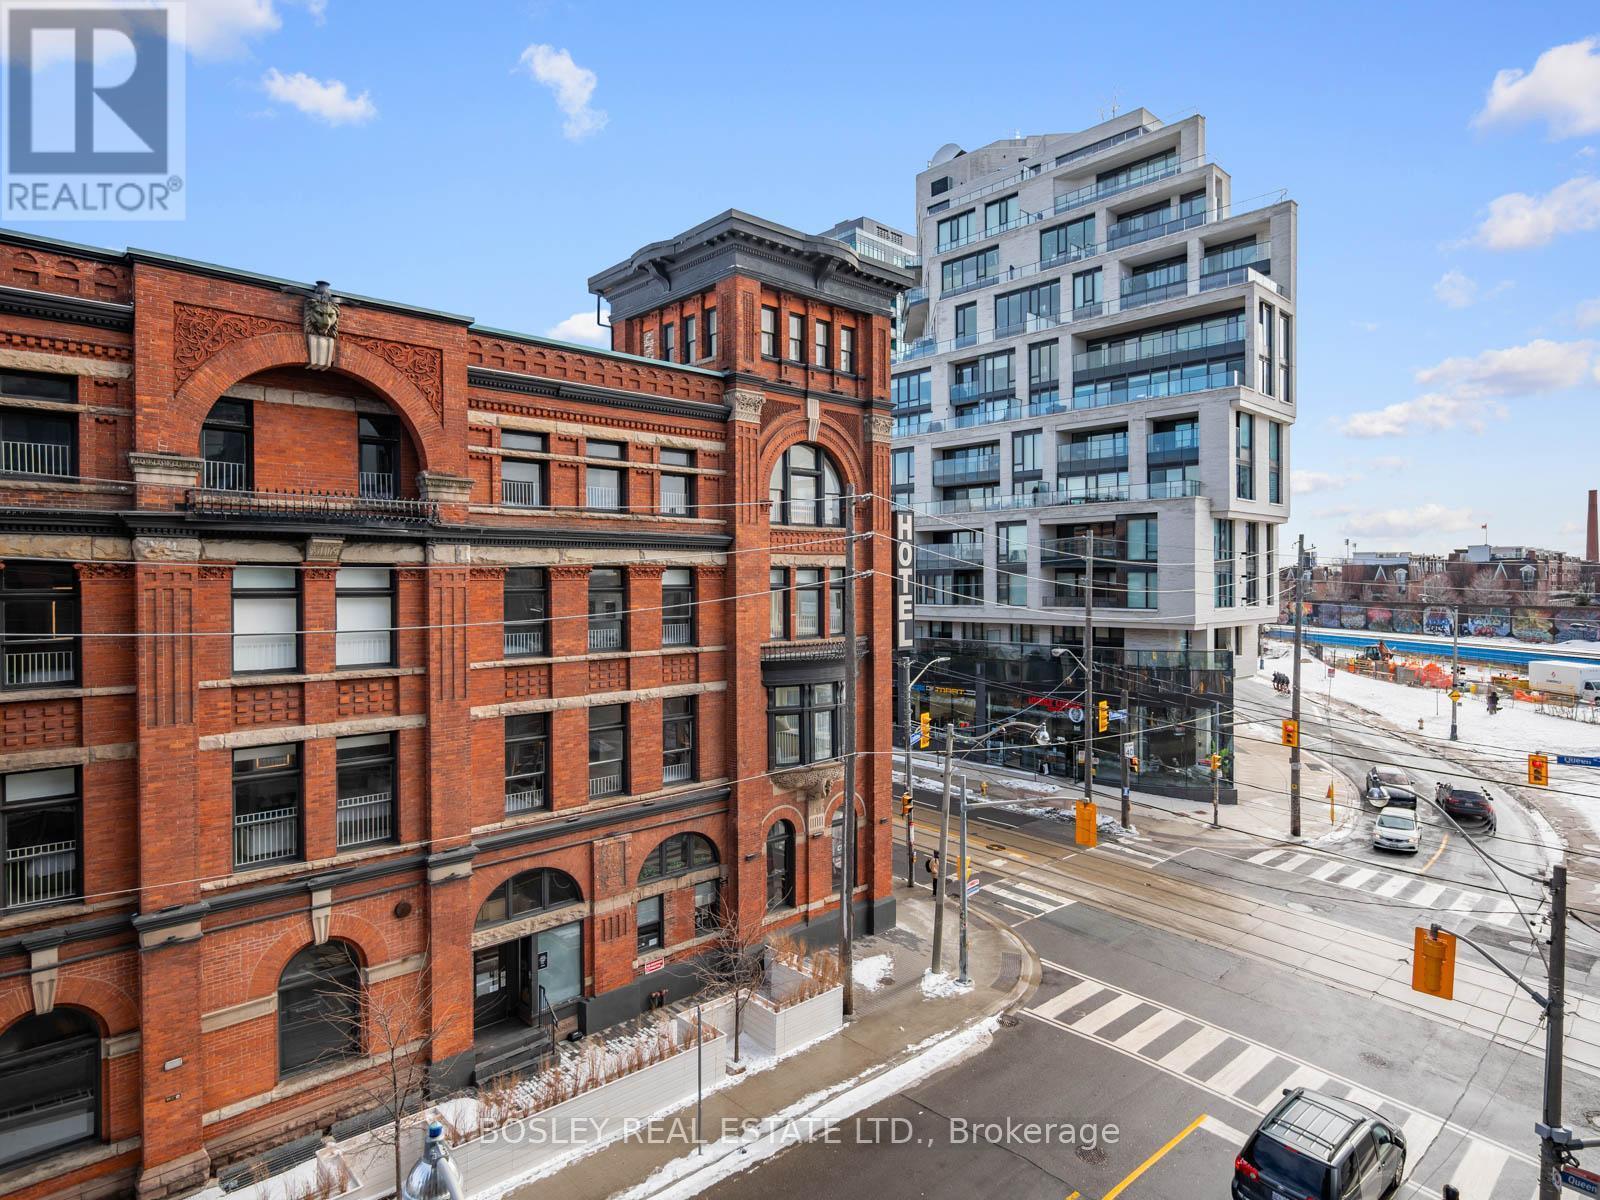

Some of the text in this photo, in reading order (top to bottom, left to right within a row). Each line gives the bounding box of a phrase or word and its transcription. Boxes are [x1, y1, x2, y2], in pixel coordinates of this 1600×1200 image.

[897, 514, 913, 647] HOTEL
[1564, 756, 1592, 765] Queen
[1568, 1176, 1597, 1193] Queen
